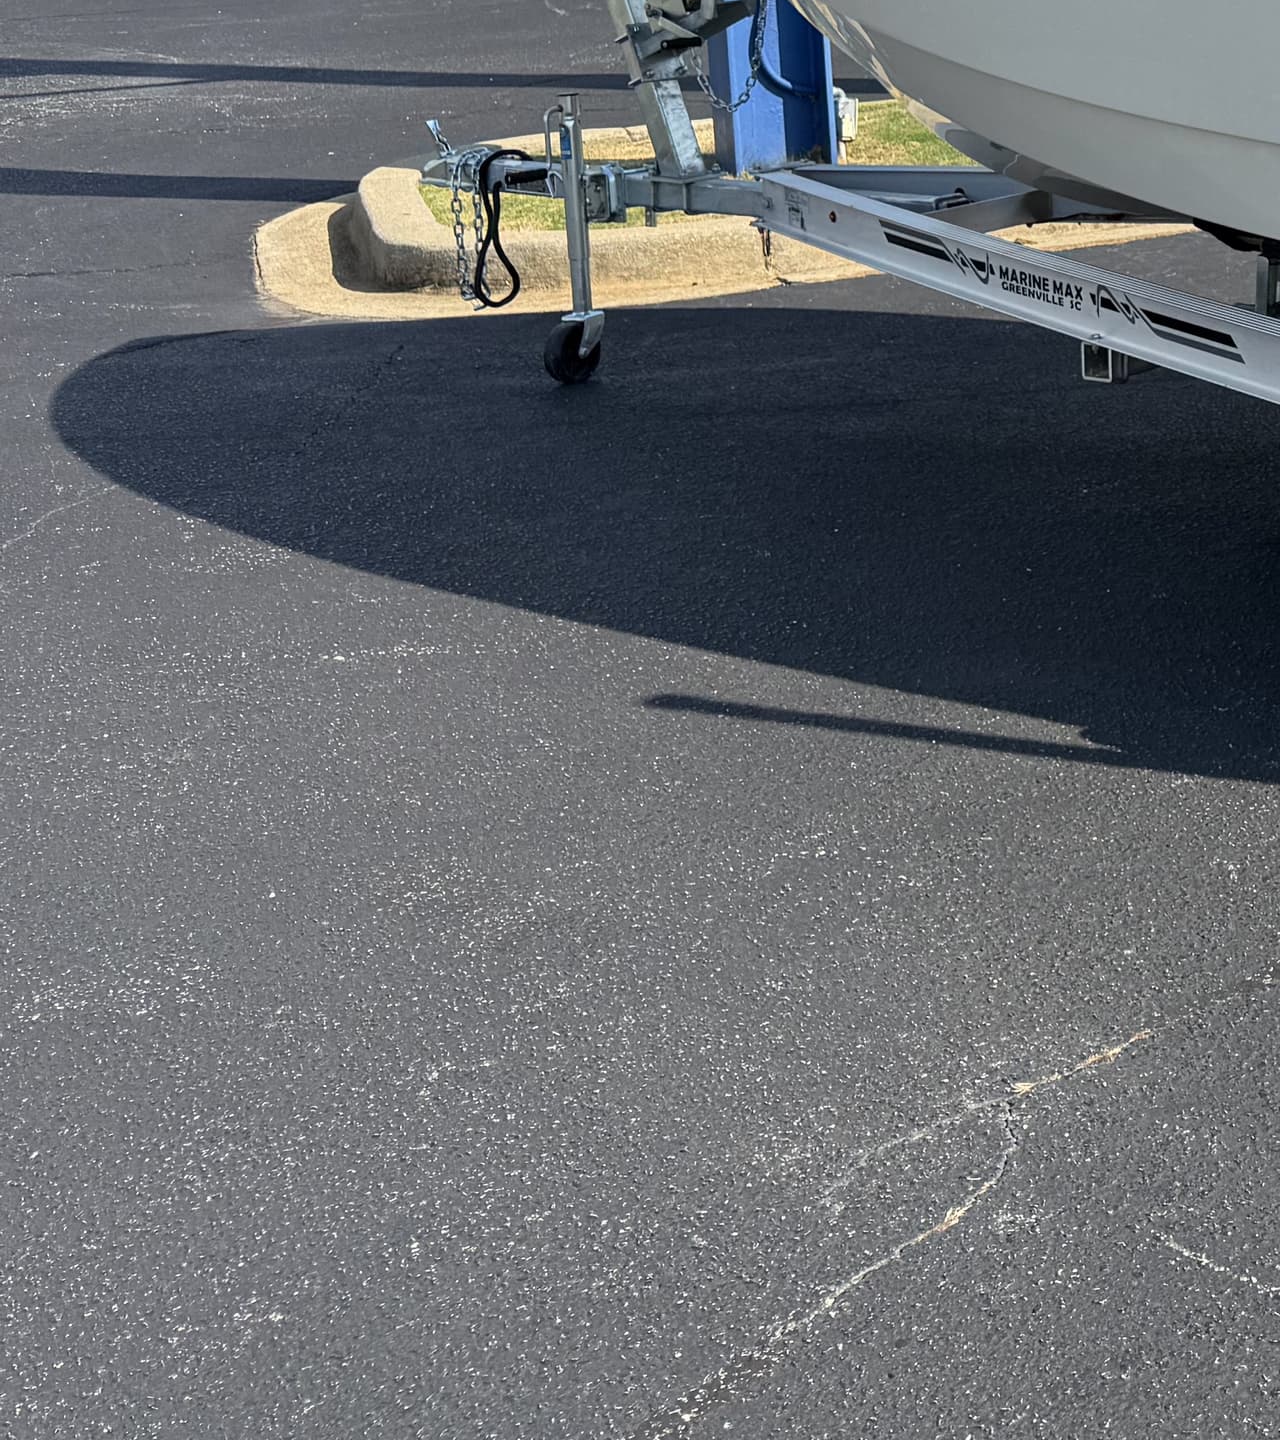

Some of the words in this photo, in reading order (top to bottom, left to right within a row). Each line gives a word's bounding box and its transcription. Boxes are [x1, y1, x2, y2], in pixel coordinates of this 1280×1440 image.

[999, 265, 1050, 292] MARINE
[1053, 280, 1083, 302] MAX
[1001, 281, 1064, 307] GREENVILLE
